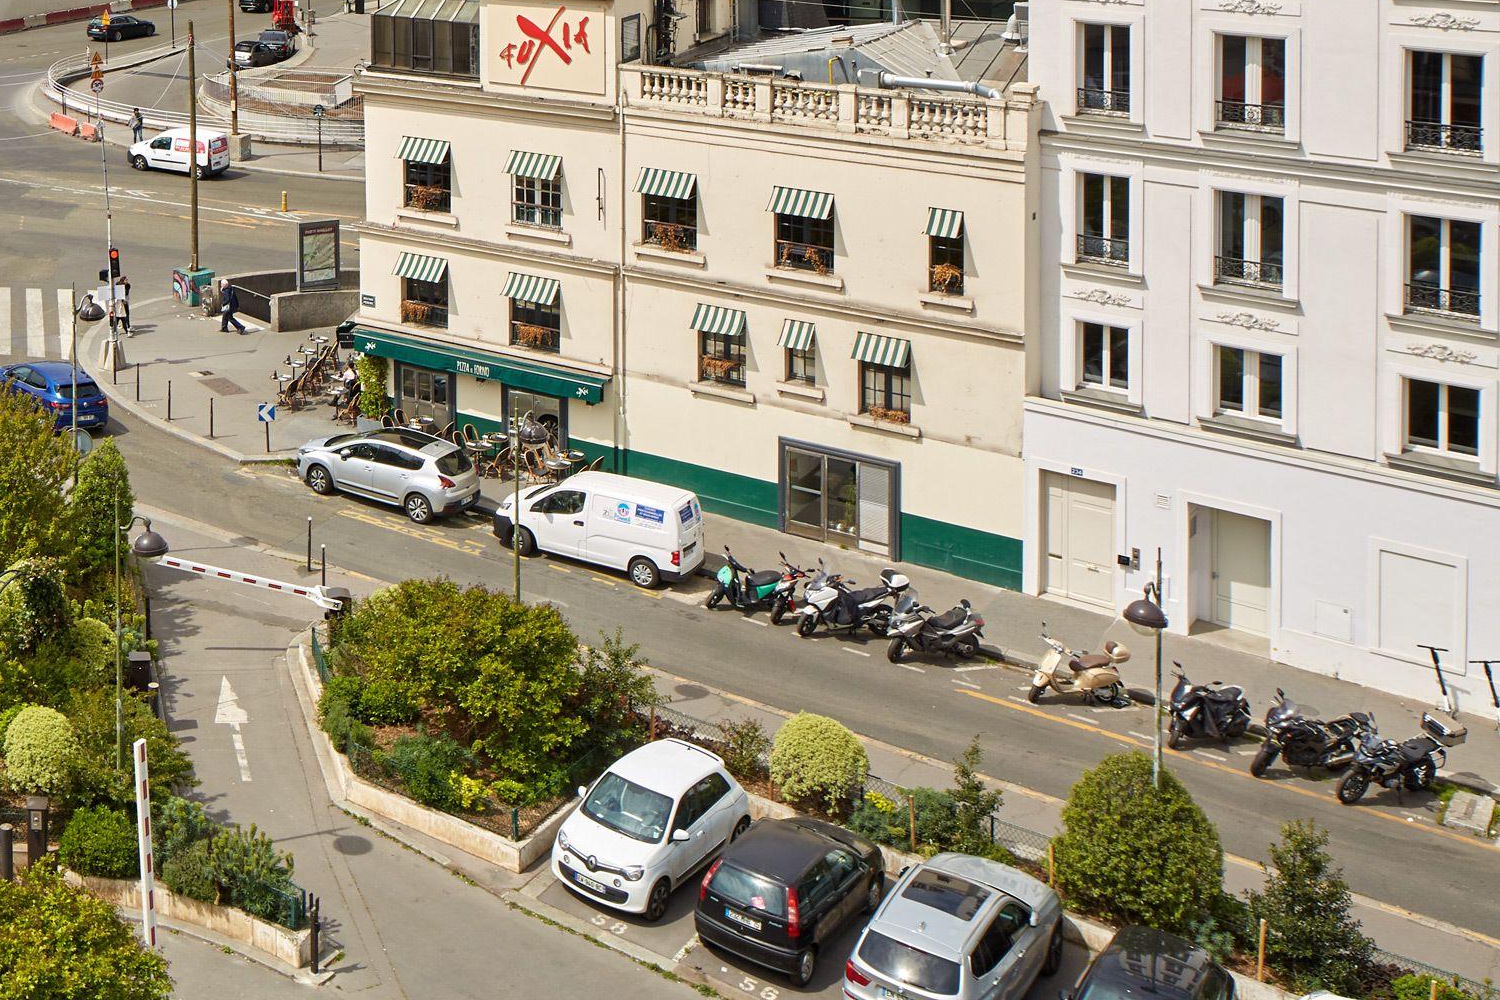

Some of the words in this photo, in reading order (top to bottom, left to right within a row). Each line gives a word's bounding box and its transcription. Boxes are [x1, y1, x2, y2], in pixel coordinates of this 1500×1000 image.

[456, 360, 470, 373] PIZZA
[473, 364, 490, 378] FORNO
[739, 976, 780, 1000] 56
